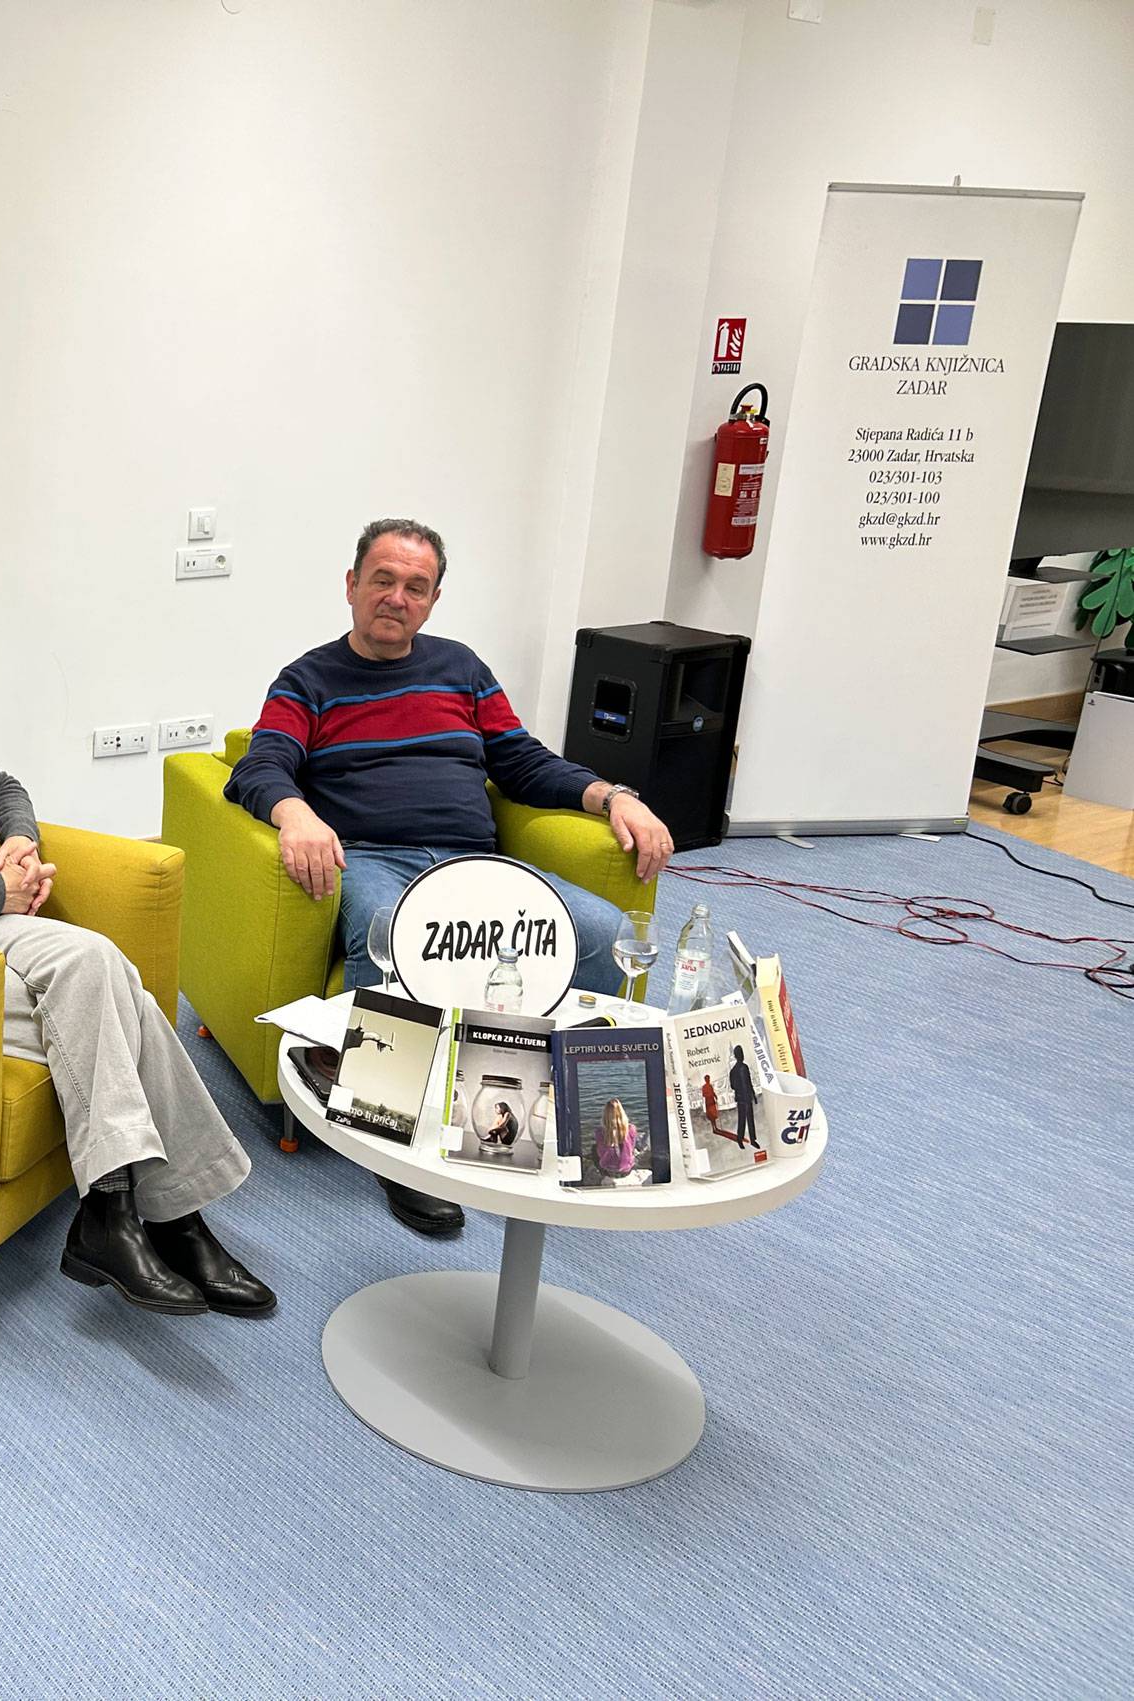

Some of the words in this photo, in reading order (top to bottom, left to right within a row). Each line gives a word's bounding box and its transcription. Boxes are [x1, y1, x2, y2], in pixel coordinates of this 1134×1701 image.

[848, 355, 920, 371] GRADSKA
[925, 353, 1005, 375] KNJIŽNICA
[896, 379, 947, 395] ZADAR
[855, 427, 903, 444] Stjepana
[906, 427, 944, 441] Radića
[948, 428, 961, 441] 11
[966, 427, 974, 441] b
[847, 448, 884, 463] 23000
[886, 448, 921, 464] Zadar,
[924, 449, 975, 463] Hrvatska
[869, 470, 943, 485] 023/301-103
[866, 491, 940, 505] 023/301-100
[858, 512, 941, 528] gkzd@gkzd.hr
[860, 533, 933, 549] www.gkzd.hr
[422, 920, 504, 962] ZADAR
[511, 909, 556, 958] ČITA
[683, 1017, 746, 1040] JEDNORUKI
[472, 1031, 502, 1042] KLOPKA
[503, 1035, 514, 1043] ZA
[514, 1035, 547, 1047] ČETVERO
[564, 1045, 596, 1054] LEPTIRI
[597, 1044, 620, 1053] VOLE
[621, 1043, 659, 1052] SVJETLO
[686, 1045, 710, 1058] Robert
[750, 1025, 774, 1084] NJIGA
[688, 1054, 721, 1069] Nezirović
[673, 1082, 689, 1139] JEDNORUKI
